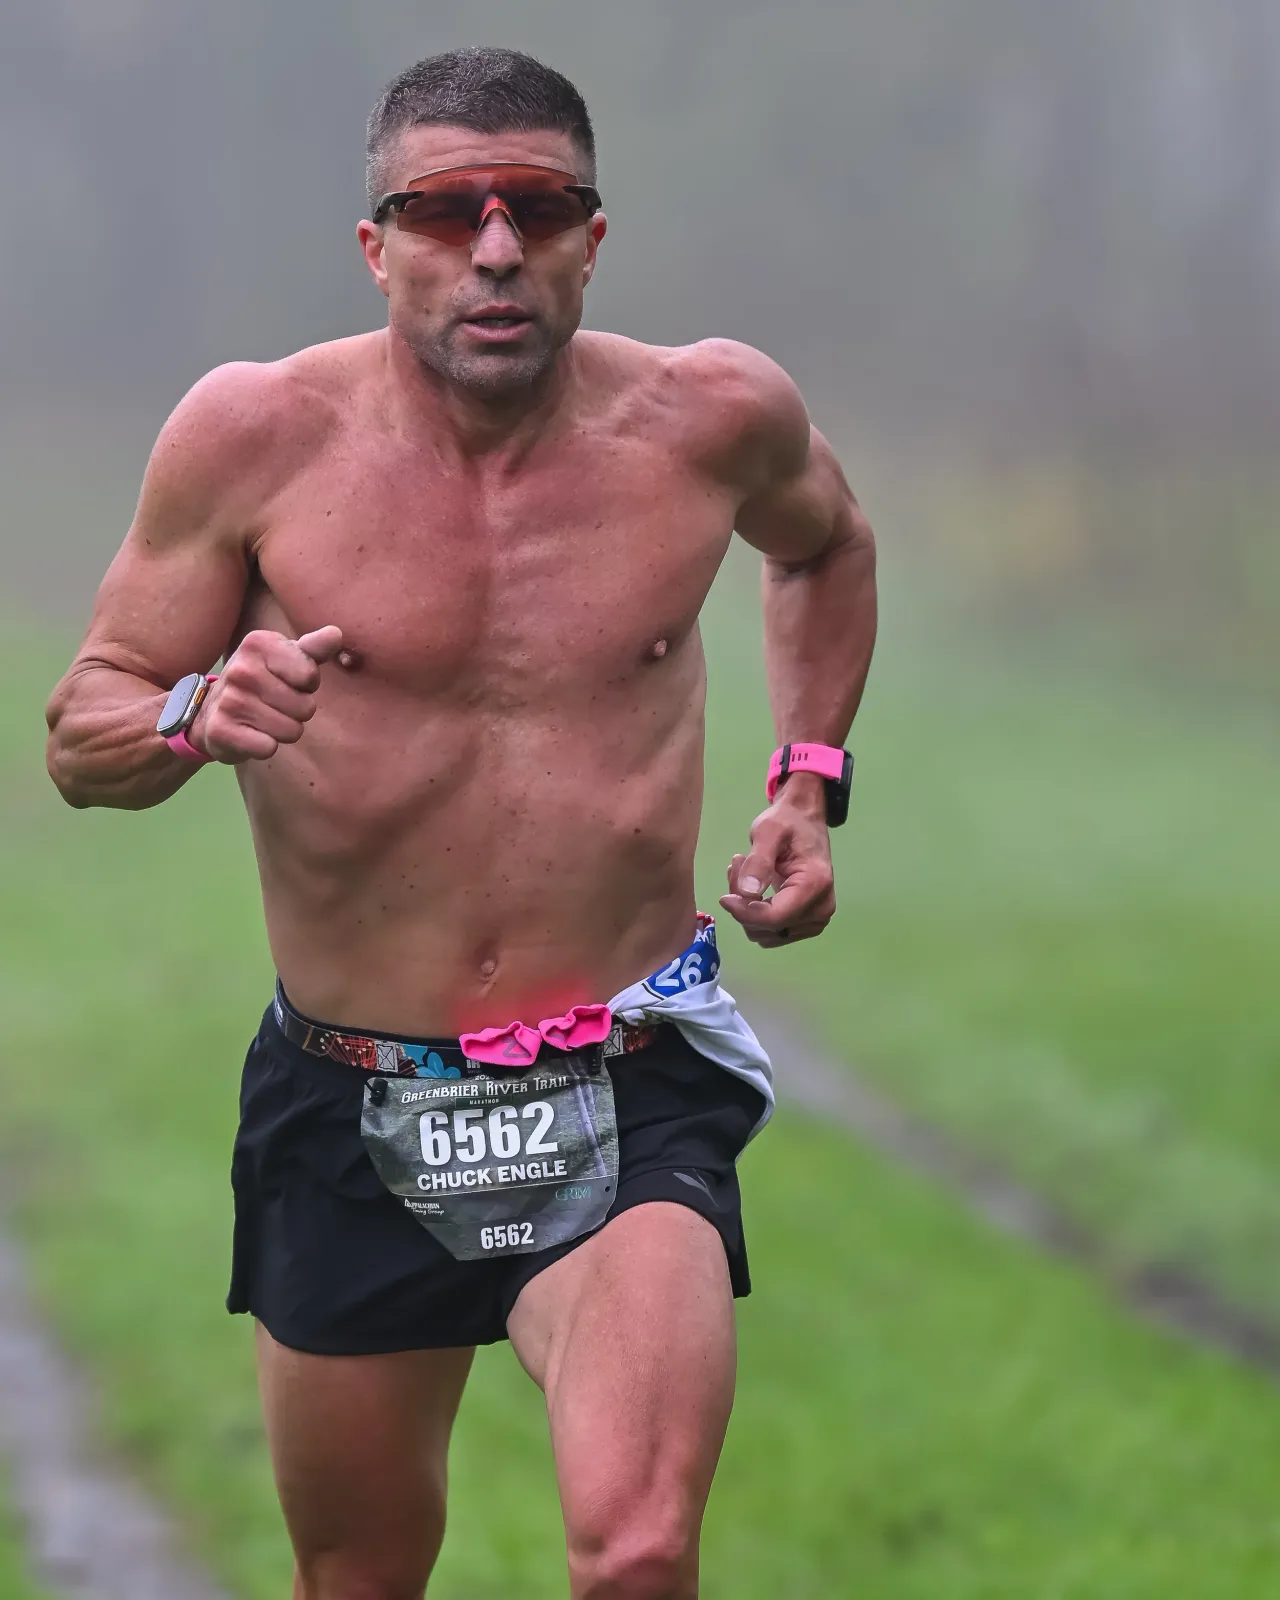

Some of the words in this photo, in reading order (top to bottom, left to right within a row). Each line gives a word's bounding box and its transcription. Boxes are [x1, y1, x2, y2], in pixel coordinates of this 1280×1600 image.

[401, 1084, 478, 1104] GREENBRIER
[486, 1080, 528, 1096] RIVER
[534, 1075, 571, 1092] TRAIL
[469, 1098, 500, 1106] MARATHON
[419, 1101, 558, 1166] 6562
[417, 1170, 493, 1190] CHUCK
[498, 1160, 567, 1183] ENGLE
[480, 1222, 534, 1250] 6562
